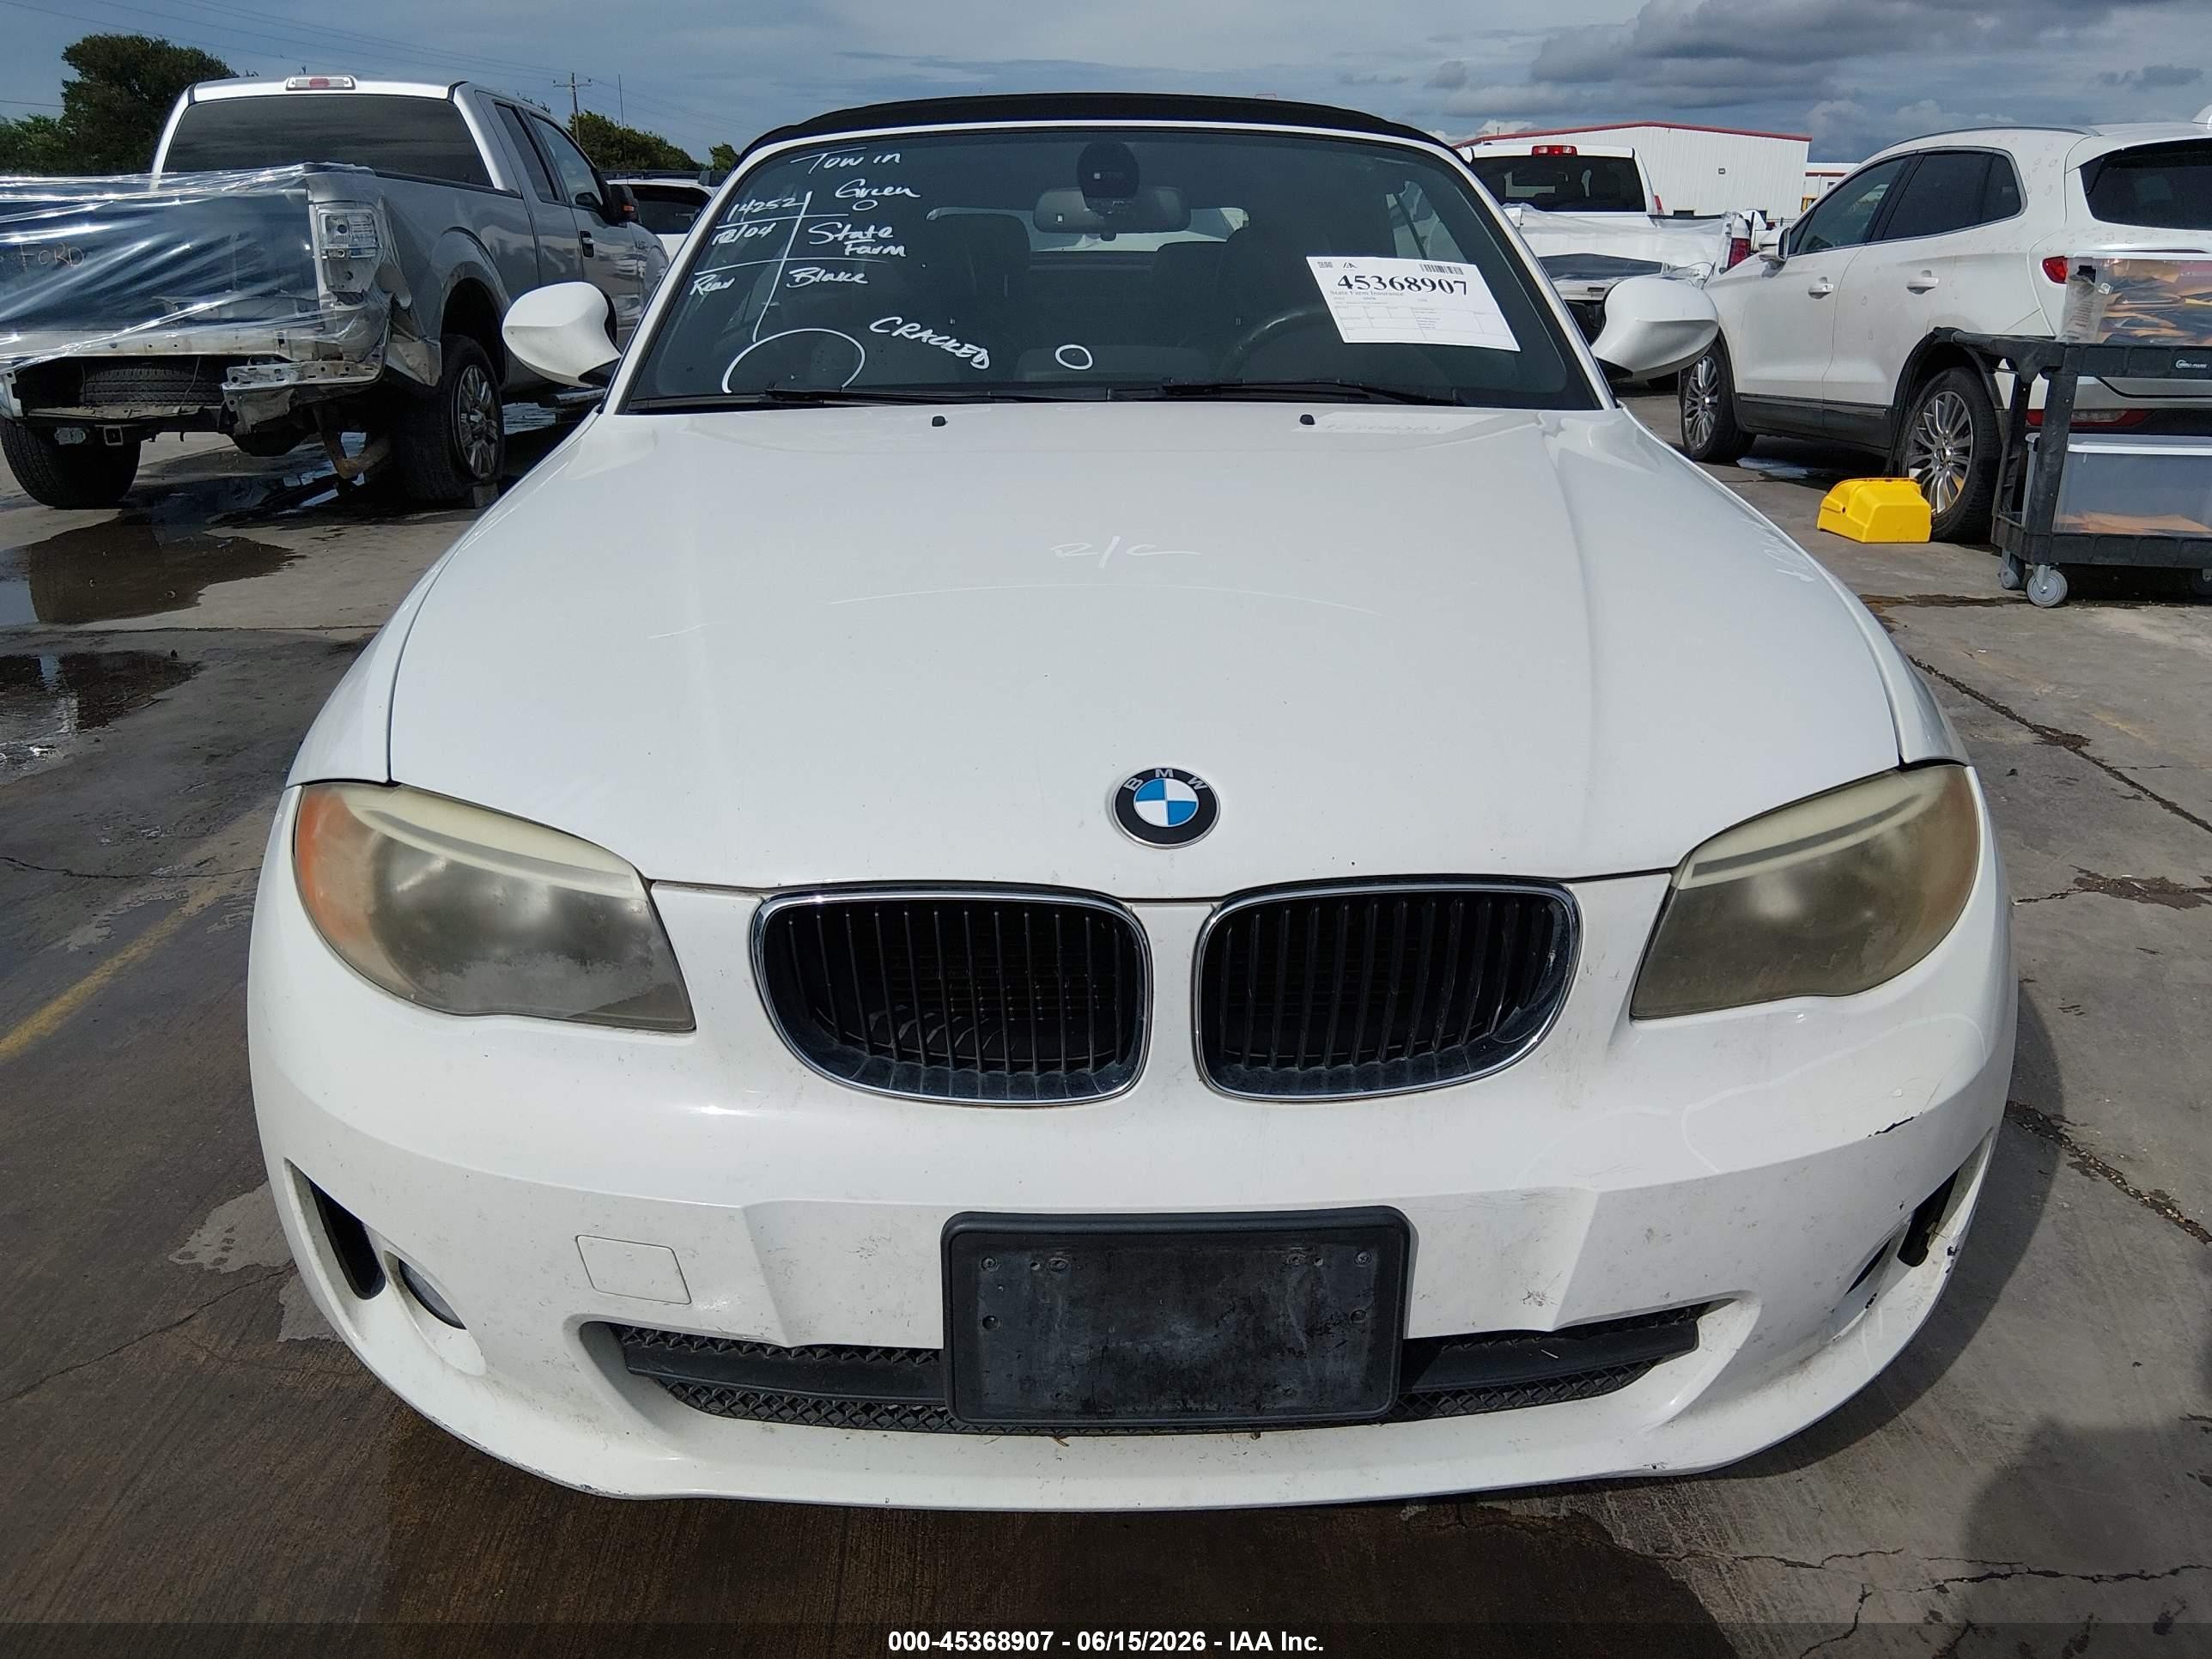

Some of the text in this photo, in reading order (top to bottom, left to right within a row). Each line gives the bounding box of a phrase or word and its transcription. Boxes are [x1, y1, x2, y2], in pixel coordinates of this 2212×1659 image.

[789, 147, 868, 174] Tow
[726, 198, 805, 222] 14252
[807, 222, 894, 245] State
[843, 239, 907, 257] Farm
[1337, 275, 1468, 295] 45368907
[1122, 769, 1208, 792] BMW
